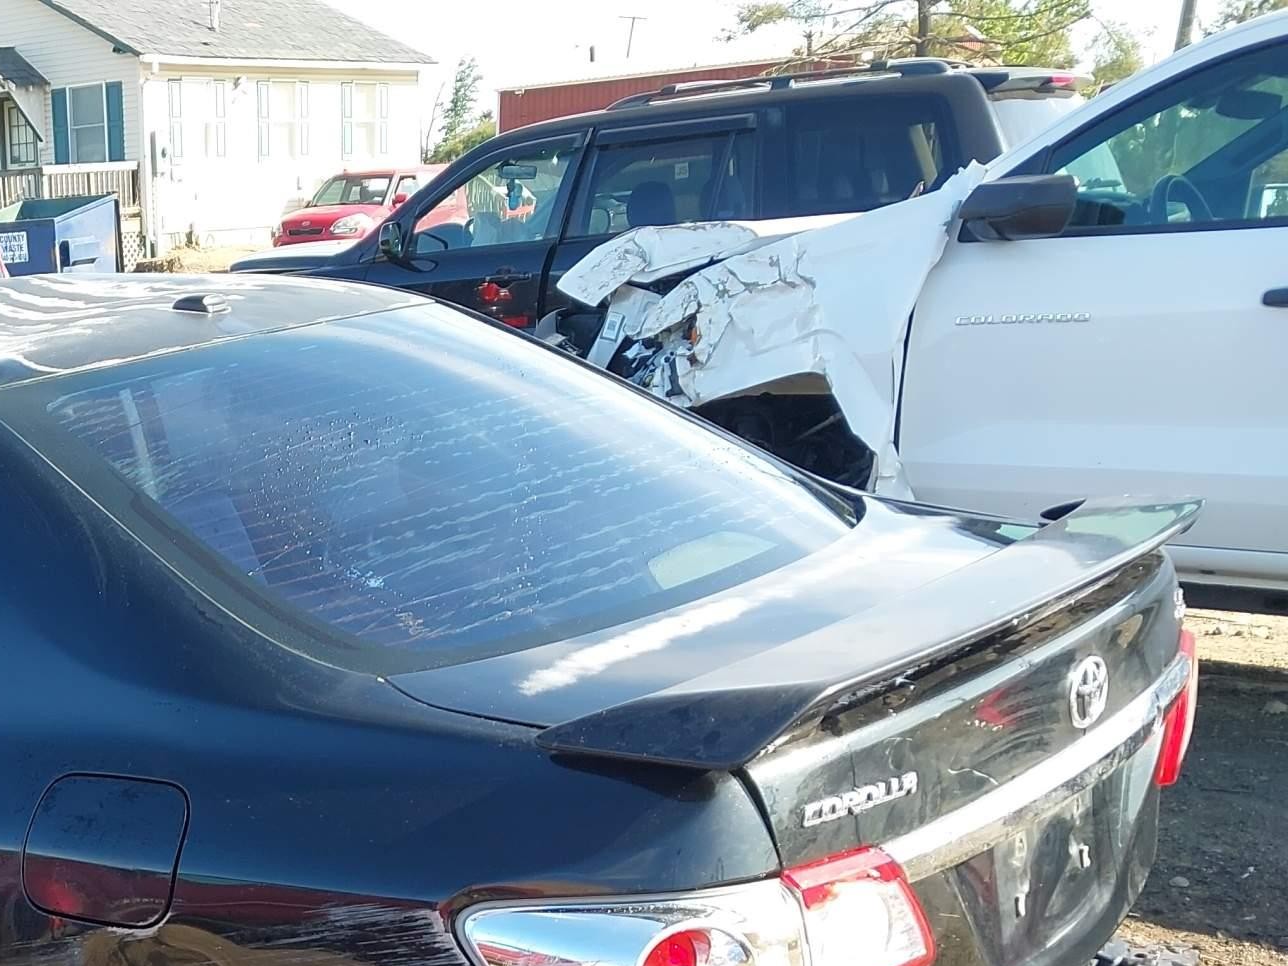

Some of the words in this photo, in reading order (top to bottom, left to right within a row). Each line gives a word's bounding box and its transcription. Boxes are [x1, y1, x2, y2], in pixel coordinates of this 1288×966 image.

[0, 234, 25, 243] COUNTY
[0, 243, 25, 253] WASTE
[954, 311, 1091, 326] COLORADO
[801, 770, 918, 828] COROLLA
